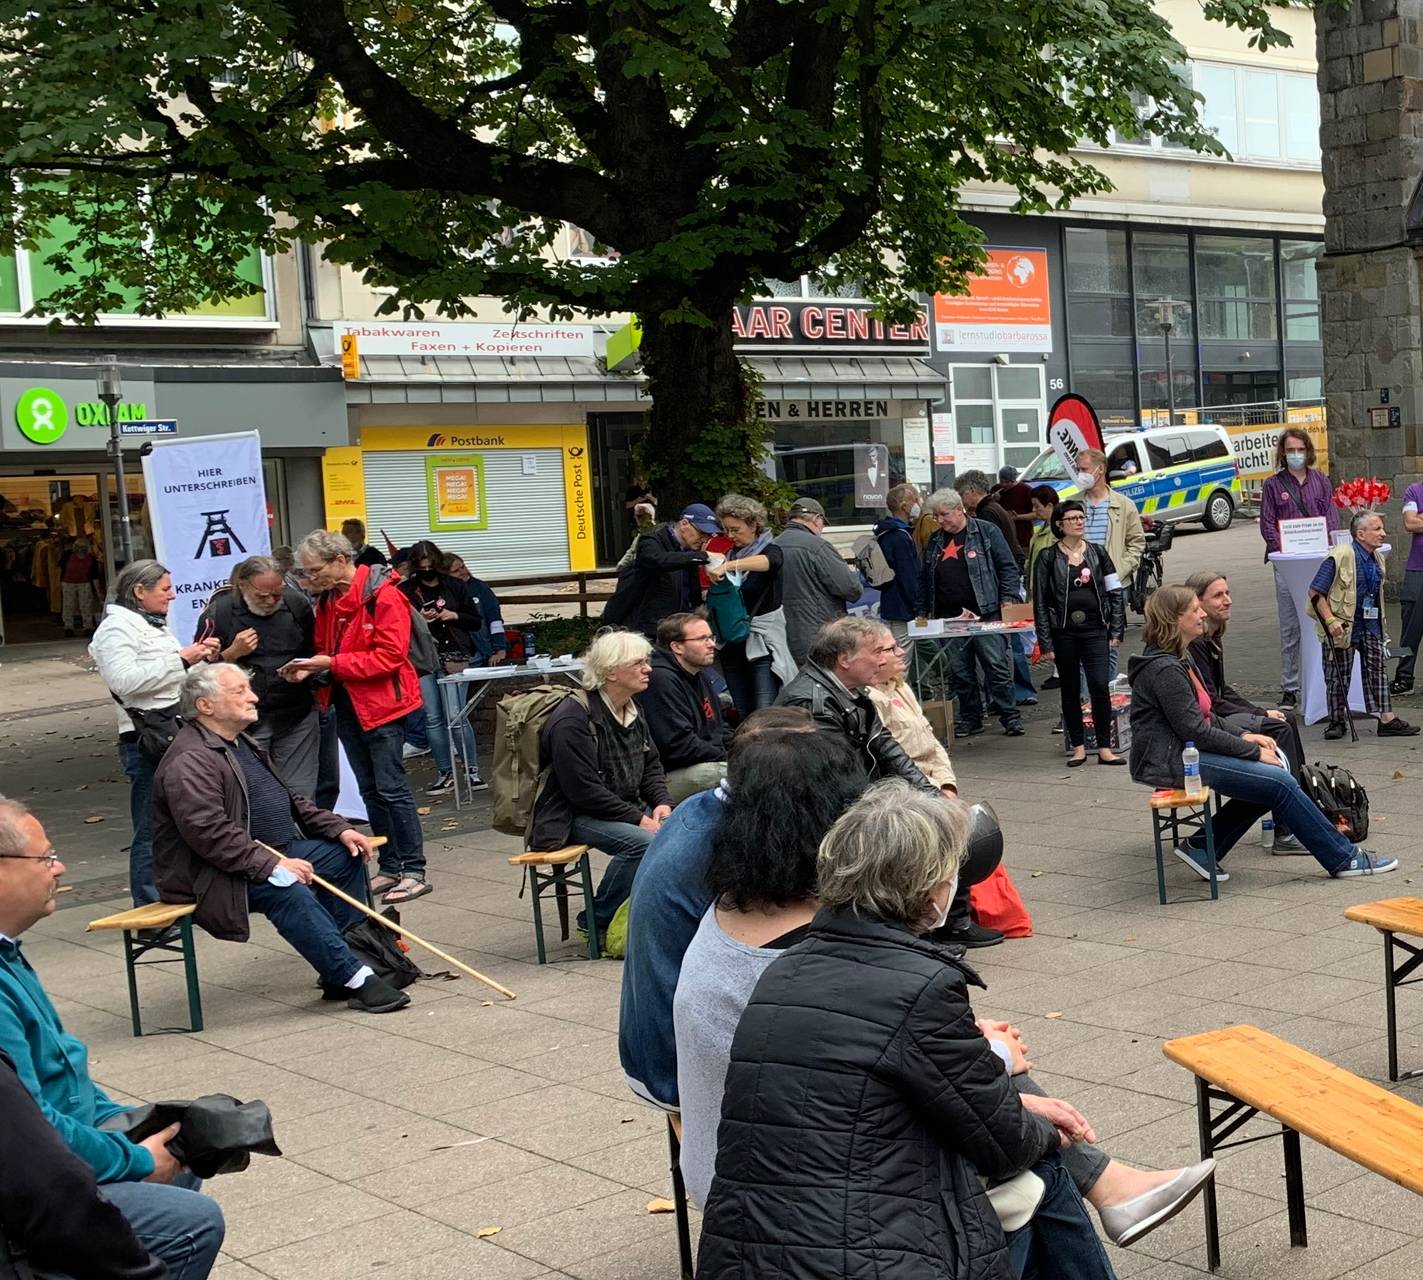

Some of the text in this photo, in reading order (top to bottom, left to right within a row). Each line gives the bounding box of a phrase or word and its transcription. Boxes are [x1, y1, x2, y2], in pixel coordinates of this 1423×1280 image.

[344, 327, 584, 339] Tabakwaren Zeitschriften
[411, 342, 456, 351] Faxen
[476, 343, 542, 353] Kopieren
[1049, 378, 1064, 390] 56
[788, 404, 800, 417] &
[808, 401, 888, 417] HERREN
[122, 423, 172, 434] Kettwiger Str.
[451, 436, 505, 446] Postbank
[1234, 433, 1279, 452] arbeite
[1237, 450, 1270, 469] ucht!
[197, 468, 223, 478] HIER
[164, 476, 257, 494] UNTERSCHREIBEN
[1121, 486, 1145, 497] OLIZEI
[574, 464, 586, 540] Deutsche Post
